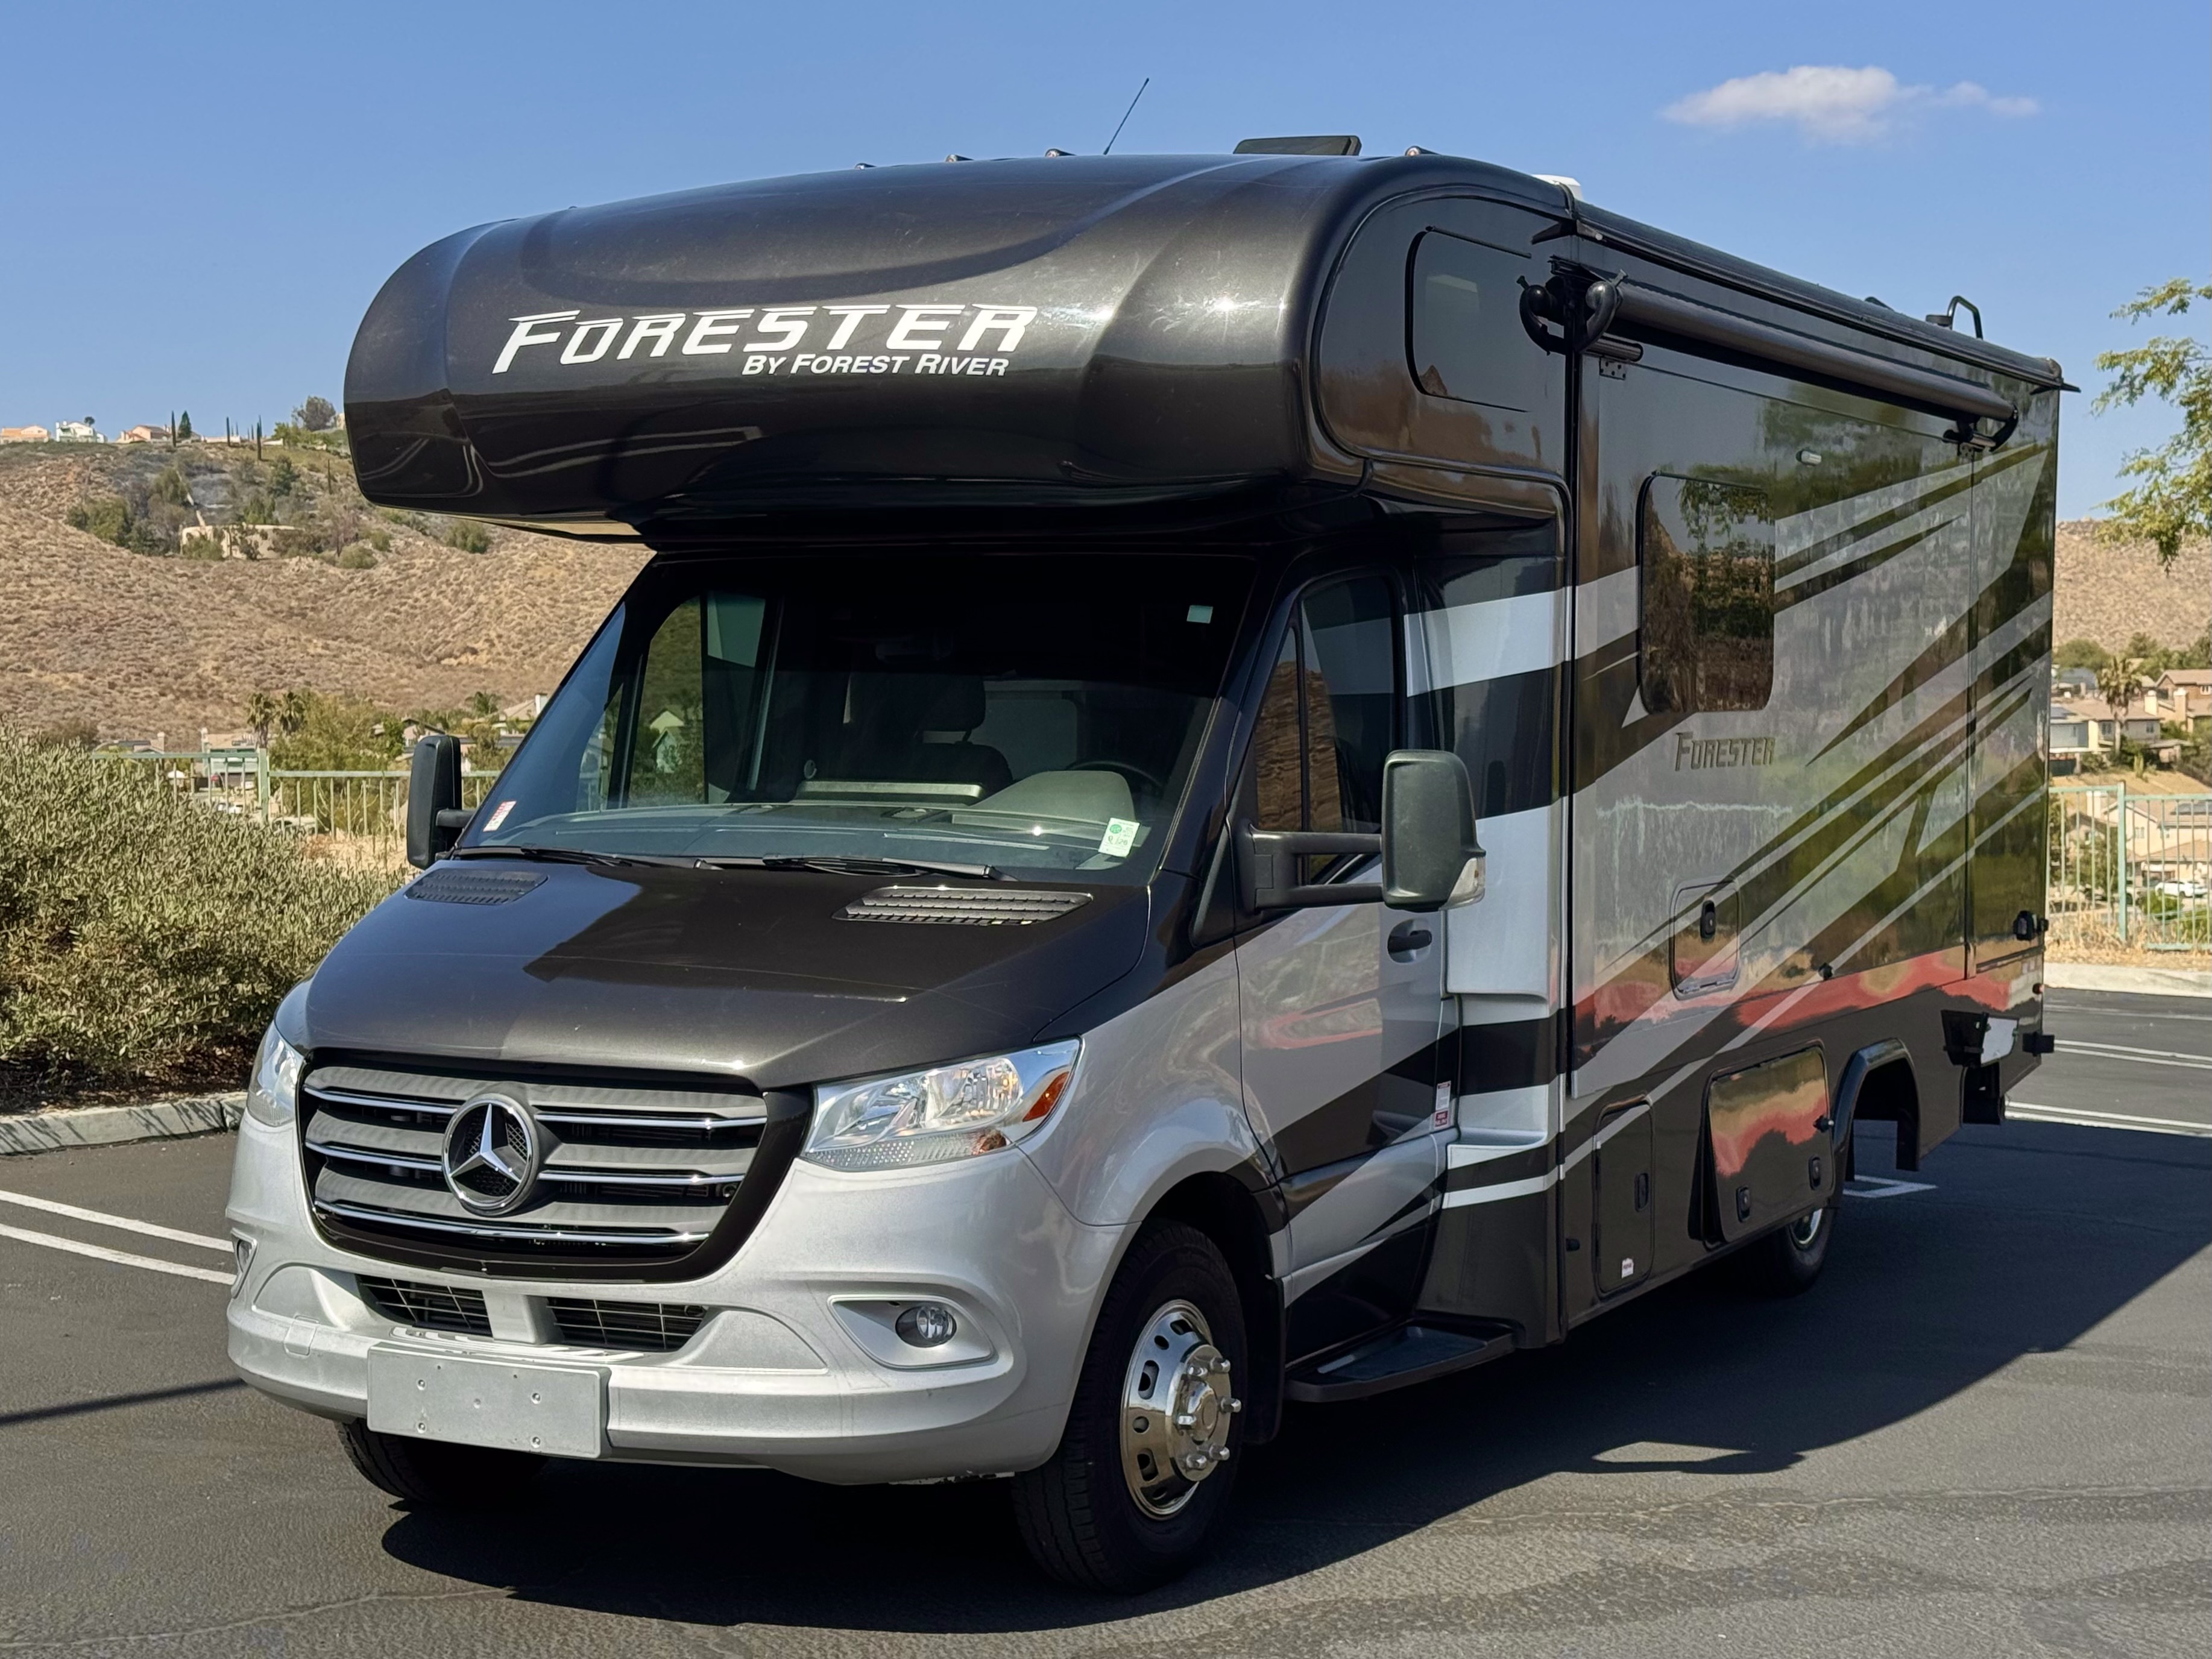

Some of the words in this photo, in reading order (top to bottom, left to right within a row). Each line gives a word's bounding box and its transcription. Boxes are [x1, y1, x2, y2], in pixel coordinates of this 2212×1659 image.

[492, 304, 1038, 374] FORESTER
[742, 355, 786, 375] BY
[790, 353, 910, 375] FOREST
[914, 354, 1009, 376] RIVER
[1675, 732, 1776, 772] FORESTER
